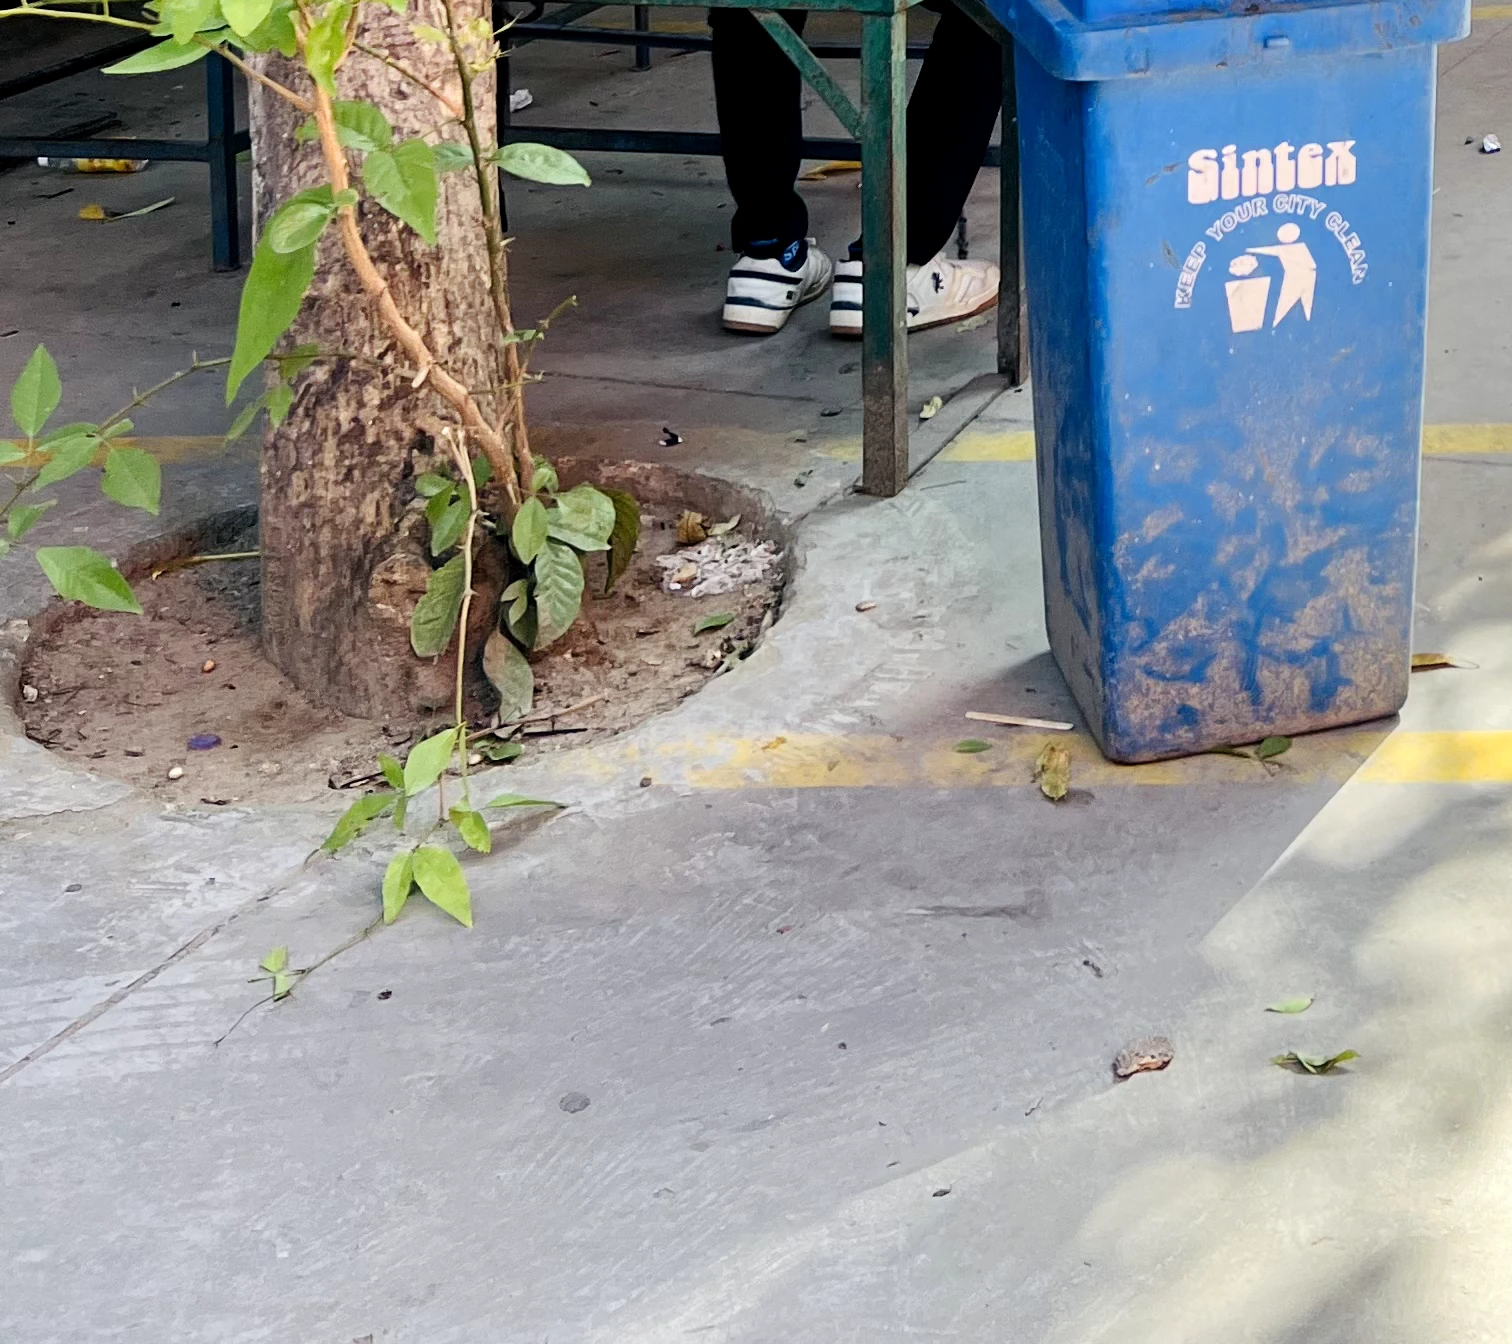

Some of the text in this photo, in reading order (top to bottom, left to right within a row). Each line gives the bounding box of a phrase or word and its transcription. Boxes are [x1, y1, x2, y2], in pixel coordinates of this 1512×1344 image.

[1187, 140, 1357, 205] Sintex
[1174, 193, 1369, 309] KEEP YOUR CITY CLEAN
